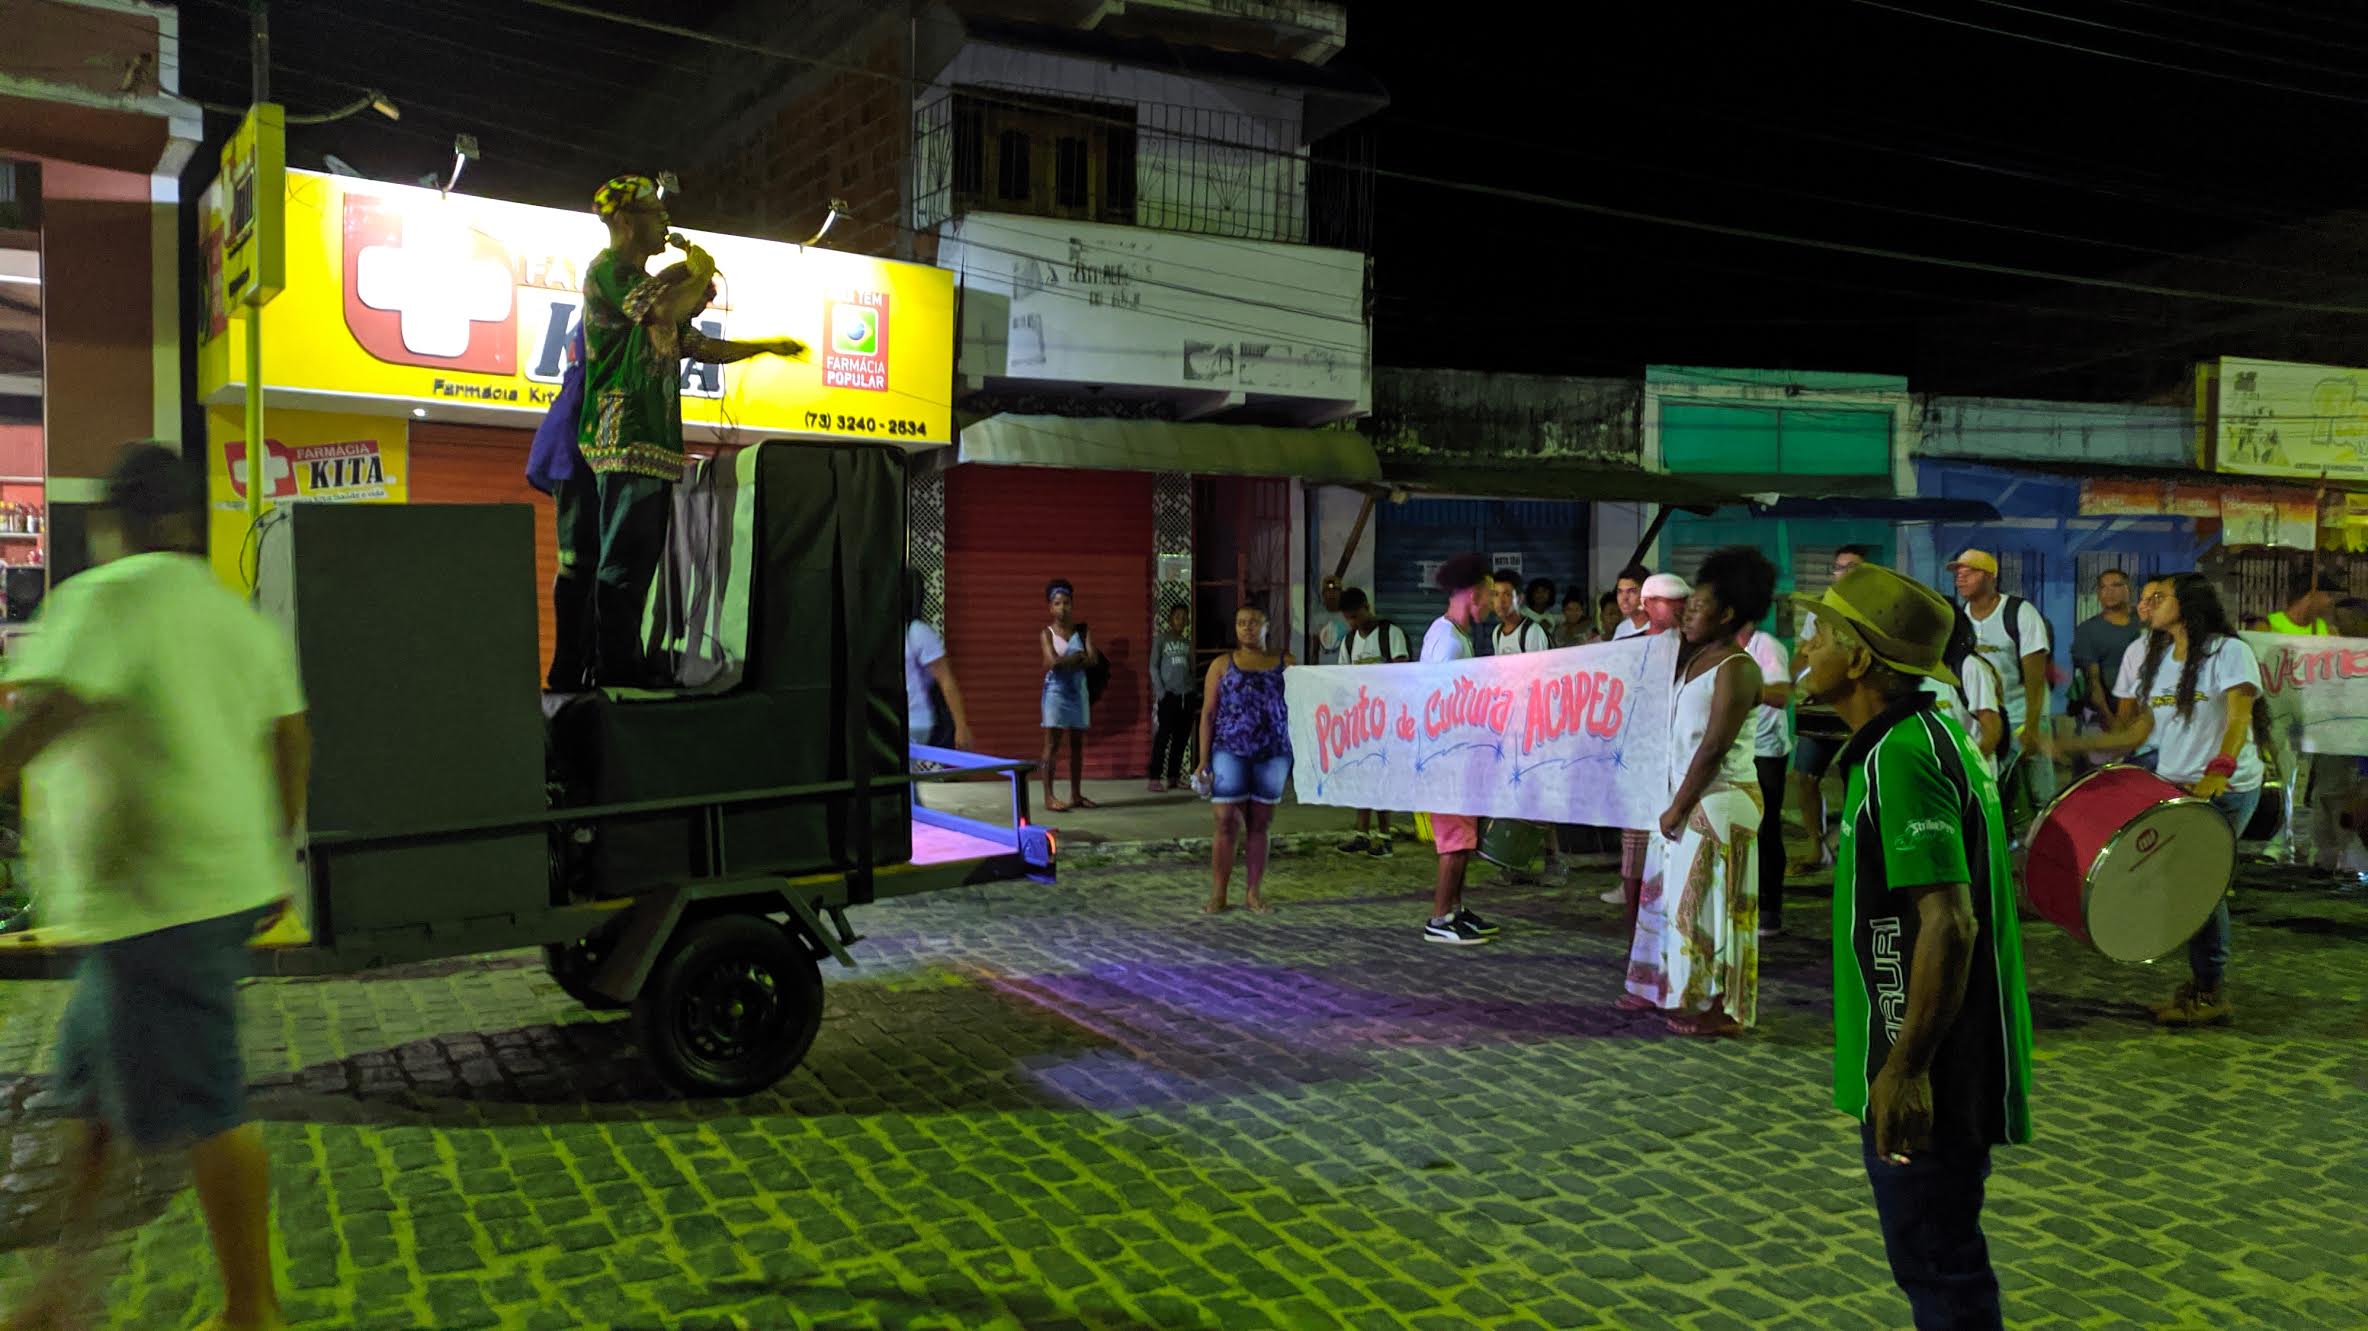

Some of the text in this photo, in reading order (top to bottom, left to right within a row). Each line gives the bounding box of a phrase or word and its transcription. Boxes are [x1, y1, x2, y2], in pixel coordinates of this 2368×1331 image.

[826, 356, 886, 374] FARMÁCIA
[826, 371, 885, 389] POPULAR
[529, 386, 558, 404] Kit
[804, 410, 831, 430] (73)
[837, 415, 876, 433] 3240
[296, 442, 370, 460] FARMÁCIA
[309, 455, 384, 489] KITA
[1314, 670, 1626, 774] Ponto de Cultura ACAPEB
